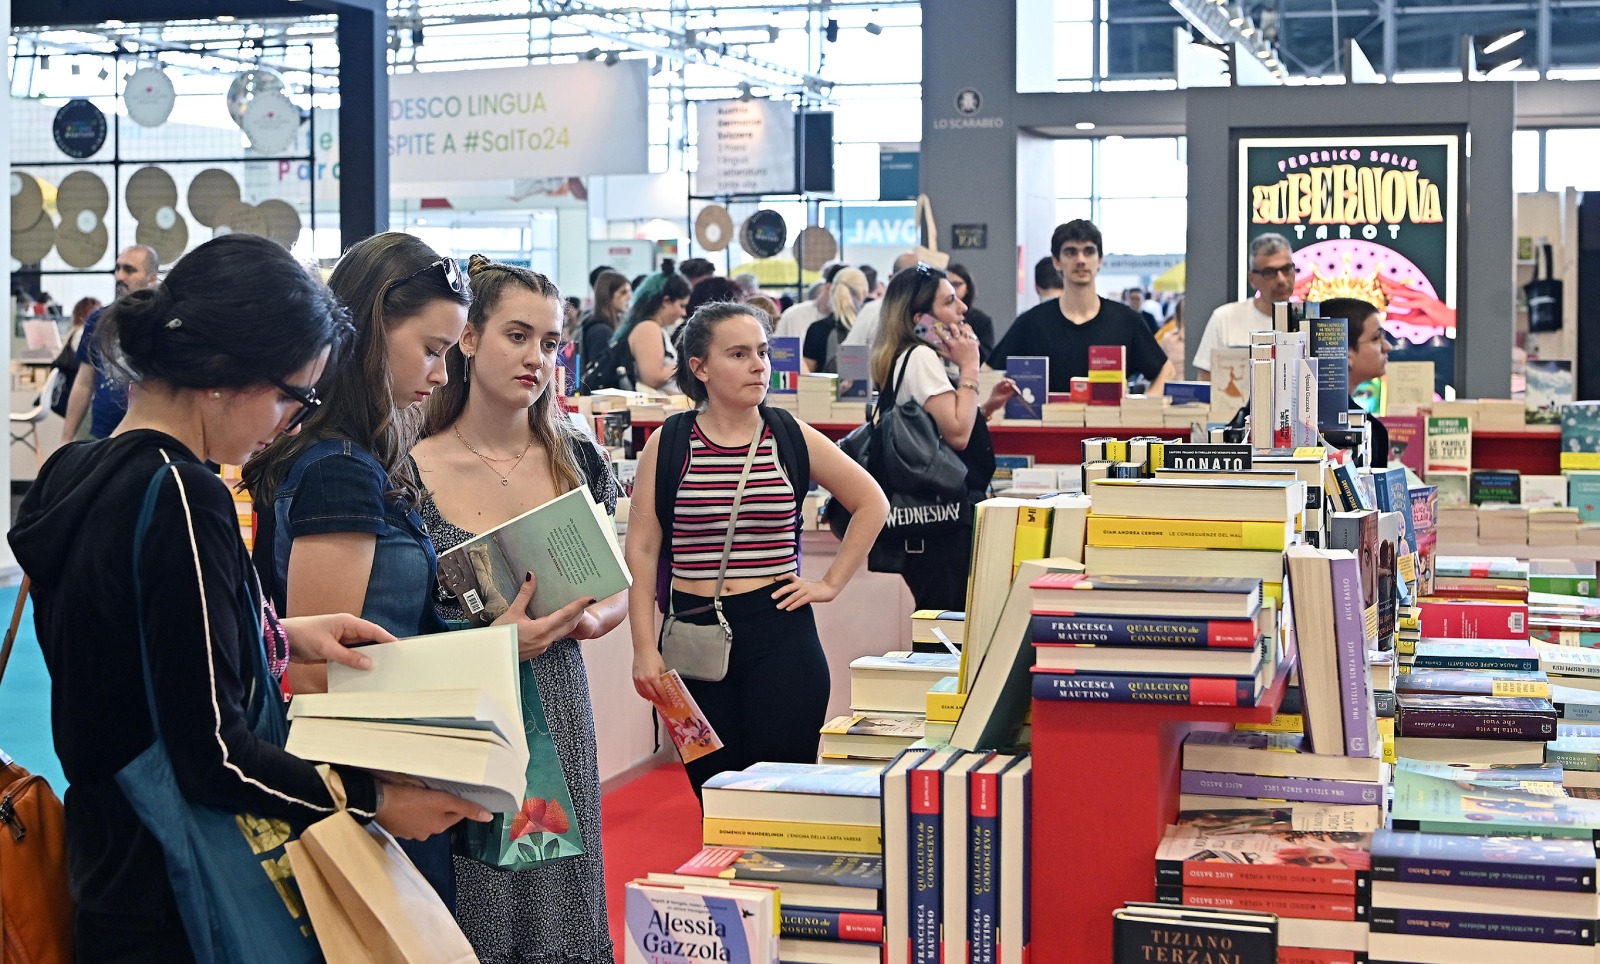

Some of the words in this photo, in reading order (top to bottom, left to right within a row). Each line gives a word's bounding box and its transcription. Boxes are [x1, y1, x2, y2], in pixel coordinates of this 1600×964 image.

[468, 92, 547, 117] LINGUA
[933, 119, 948, 129] LO
[442, 132, 456, 154] A
[464, 127, 571, 153] #SalTo24
[1278, 149, 1361, 172] FEDERICO
[1369, 150, 1418, 170] SALIS
[1252, 164, 1444, 225] SUPERNOVA
[1294, 224, 1400, 240] TAROT
[1437, 419, 1460, 427] SERGIO
[1429, 426, 1469, 435] MATTARELLA
[1429, 440, 1437, 448] LE
[1429, 448, 1437, 456] DI
[1442, 448, 1467, 456] TUTTI
[1174, 457, 1243, 470] DONATO
[885, 502, 960, 529] WEDNESDAY
[1413, 506, 1426, 515] ALICE
[1413, 513, 1429, 523] CLAIR
[1342, 578, 1350, 601] BASSO
[1344, 602, 1352, 621] ALICE
[1051, 622, 1114, 632] FRANCESCA
[1126, 624, 1188, 634] QUALCUNO
[1057, 632, 1108, 641] MAUTINO
[1130, 635, 1196, 643] CONOSCEVO
[1053, 680, 1115, 689] FRANCESCA
[1127, 682, 1189, 692] QUALCUNO
[1059, 690, 1109, 699] MAUTINO
[1131, 692, 1190, 701] CONOSCEV
[1200, 780, 1223, 788] BASSO
[1263, 784, 1280, 792] LUCE
[917, 834, 925, 891] QUALCUNO
[974, 837, 982, 896] QUALCUNO
[1189, 869, 1213, 878] BASSO
[1215, 871, 1233, 879] ALICE
[1407, 867, 1430, 876] Basso
[1431, 868, 1451, 877] Alice
[1459, 870, 1487, 878] mistero
[1489, 872, 1499, 880] del
[1501, 872, 1535, 881] scrittrice
[1189, 897, 1213, 905] BASSO
[1215, 898, 1233, 906] ALICE
[648, 909, 727, 937] Alessia
[1407, 919, 1429, 928] Basso
[1431, 920, 1450, 929] Alice
[1459, 922, 1486, 930] mistero
[1488, 924, 1498, 932] del
[1500, 924, 1534, 933] scrittrice
[1535, 926, 1544, 934] La
[927, 910, 935, 959] MAUTINO
[983, 914, 991, 964] MAUTINO
[1150, 930, 1233, 949] TIZIANO
[643, 932, 731, 962] Gazzola
[1141, 946, 1242, 964] TERZANI
